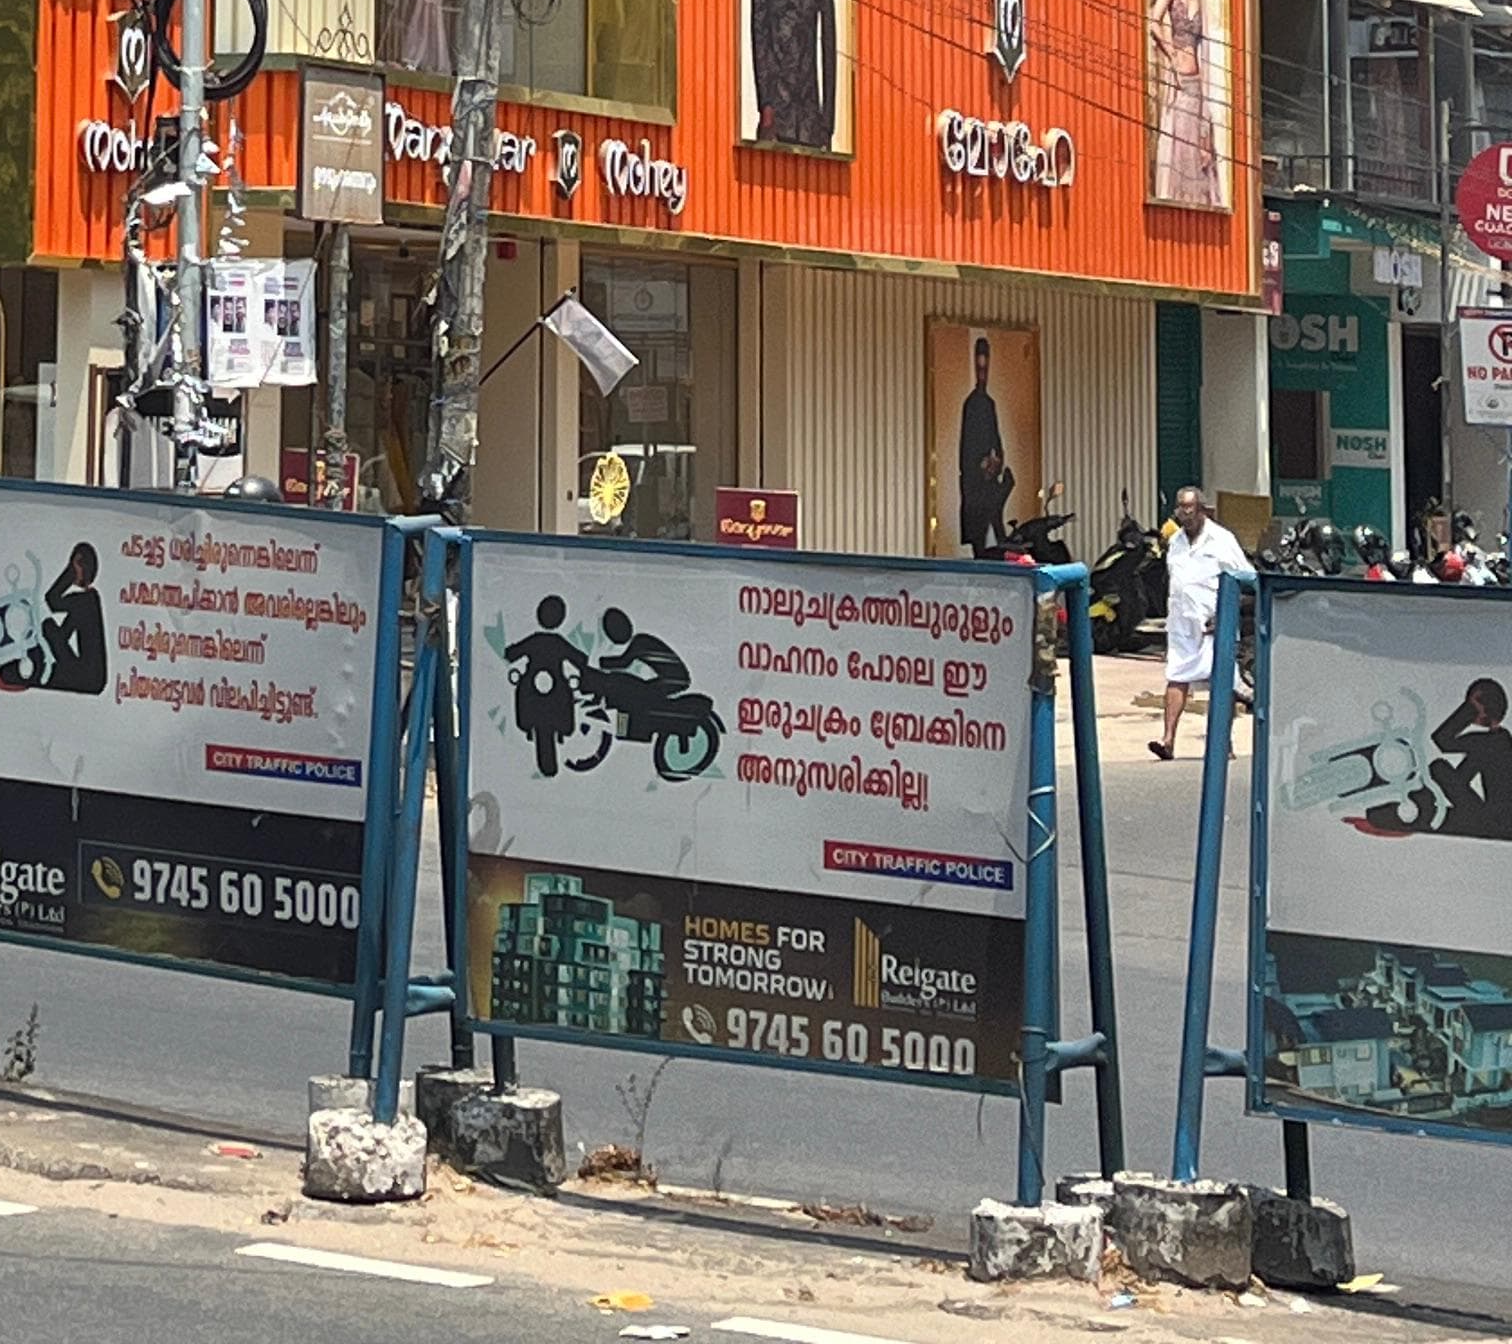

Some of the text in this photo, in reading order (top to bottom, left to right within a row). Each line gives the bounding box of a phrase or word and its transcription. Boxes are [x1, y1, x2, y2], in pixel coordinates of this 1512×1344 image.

[601, 138, 688, 214] Mohey
[1270, 314, 1358, 353] OSH
[1336, 434, 1387, 452] NOSH
[739, 641, 987, 698] വാഹനം പോലെ ഈ
[213, 752, 356, 781] CITY TRAFFIC POLICE
[832, 848, 1005, 883] CITY TRAFFIC POLICE
[133, 859, 360, 929] 9745 60 5000
[685, 916, 825, 952] HOMES FOR
[684, 940, 781, 971] STRONG
[880, 954, 977, 1000] Reigate
[728, 1008, 976, 1075] 9745 60 5000
